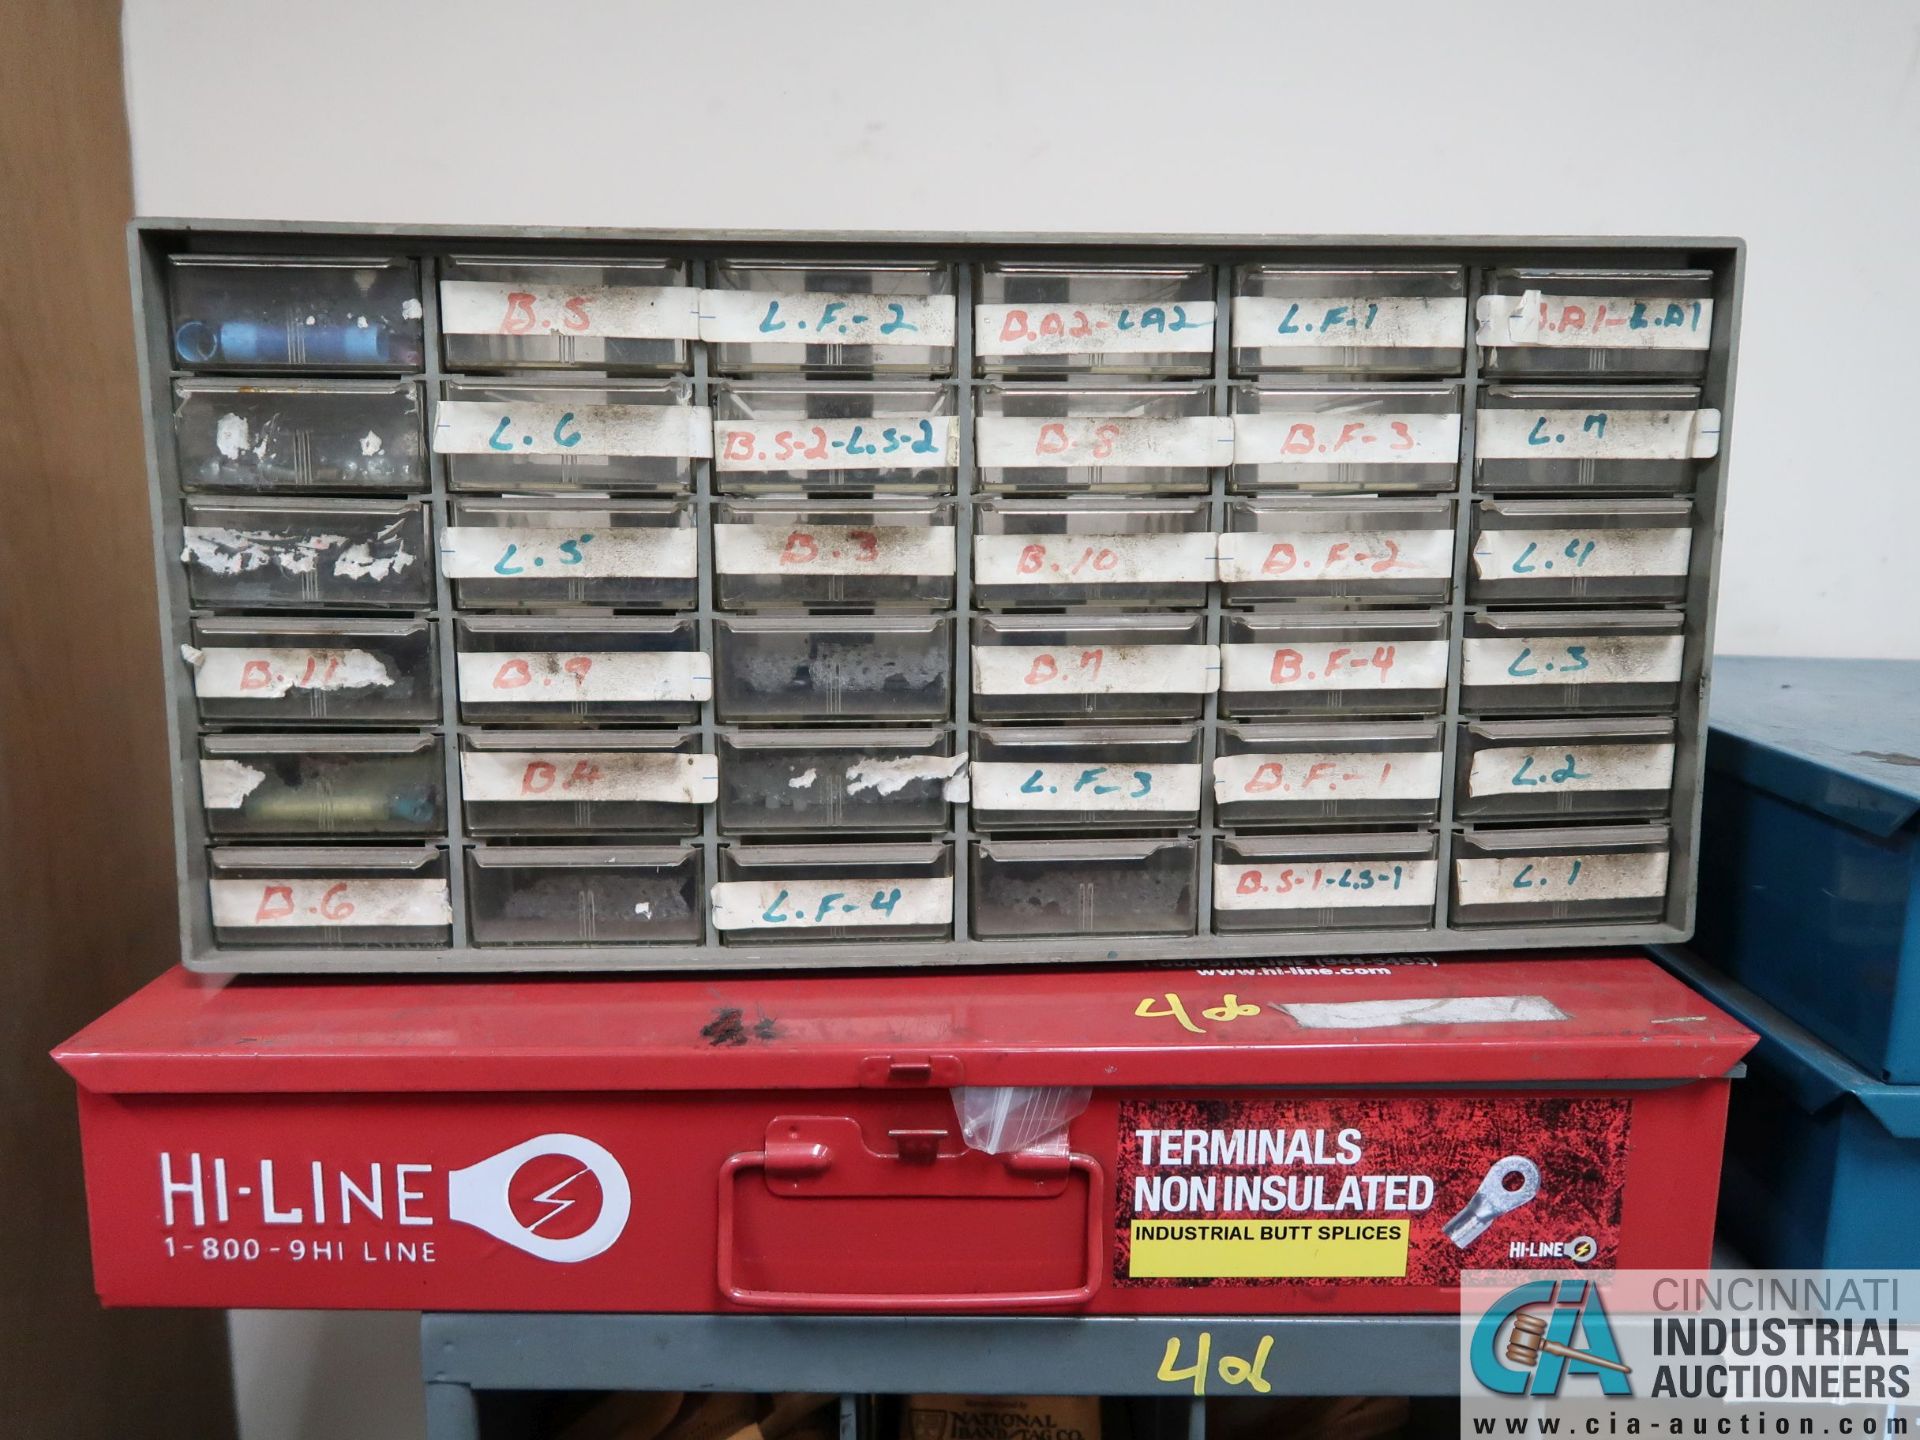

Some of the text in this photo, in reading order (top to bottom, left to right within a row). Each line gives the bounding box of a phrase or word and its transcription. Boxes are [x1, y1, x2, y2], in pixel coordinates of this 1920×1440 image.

[1196, 966, 1391, 977] www.hi-line.com
[1135, 1128, 1362, 1166] TERMINALS
[160, 1152, 433, 1226] HI-LINE
[1133, 1175, 1434, 1212] NON INSULATED
[1135, 1225, 1402, 1241] INDUSTRIAL BUTT SPLICES
[364, 1241, 437, 1262] LINE
[1510, 1240, 1564, 1258] HI-LINE
[951, 1411, 1057, 1429] NATIONAL
